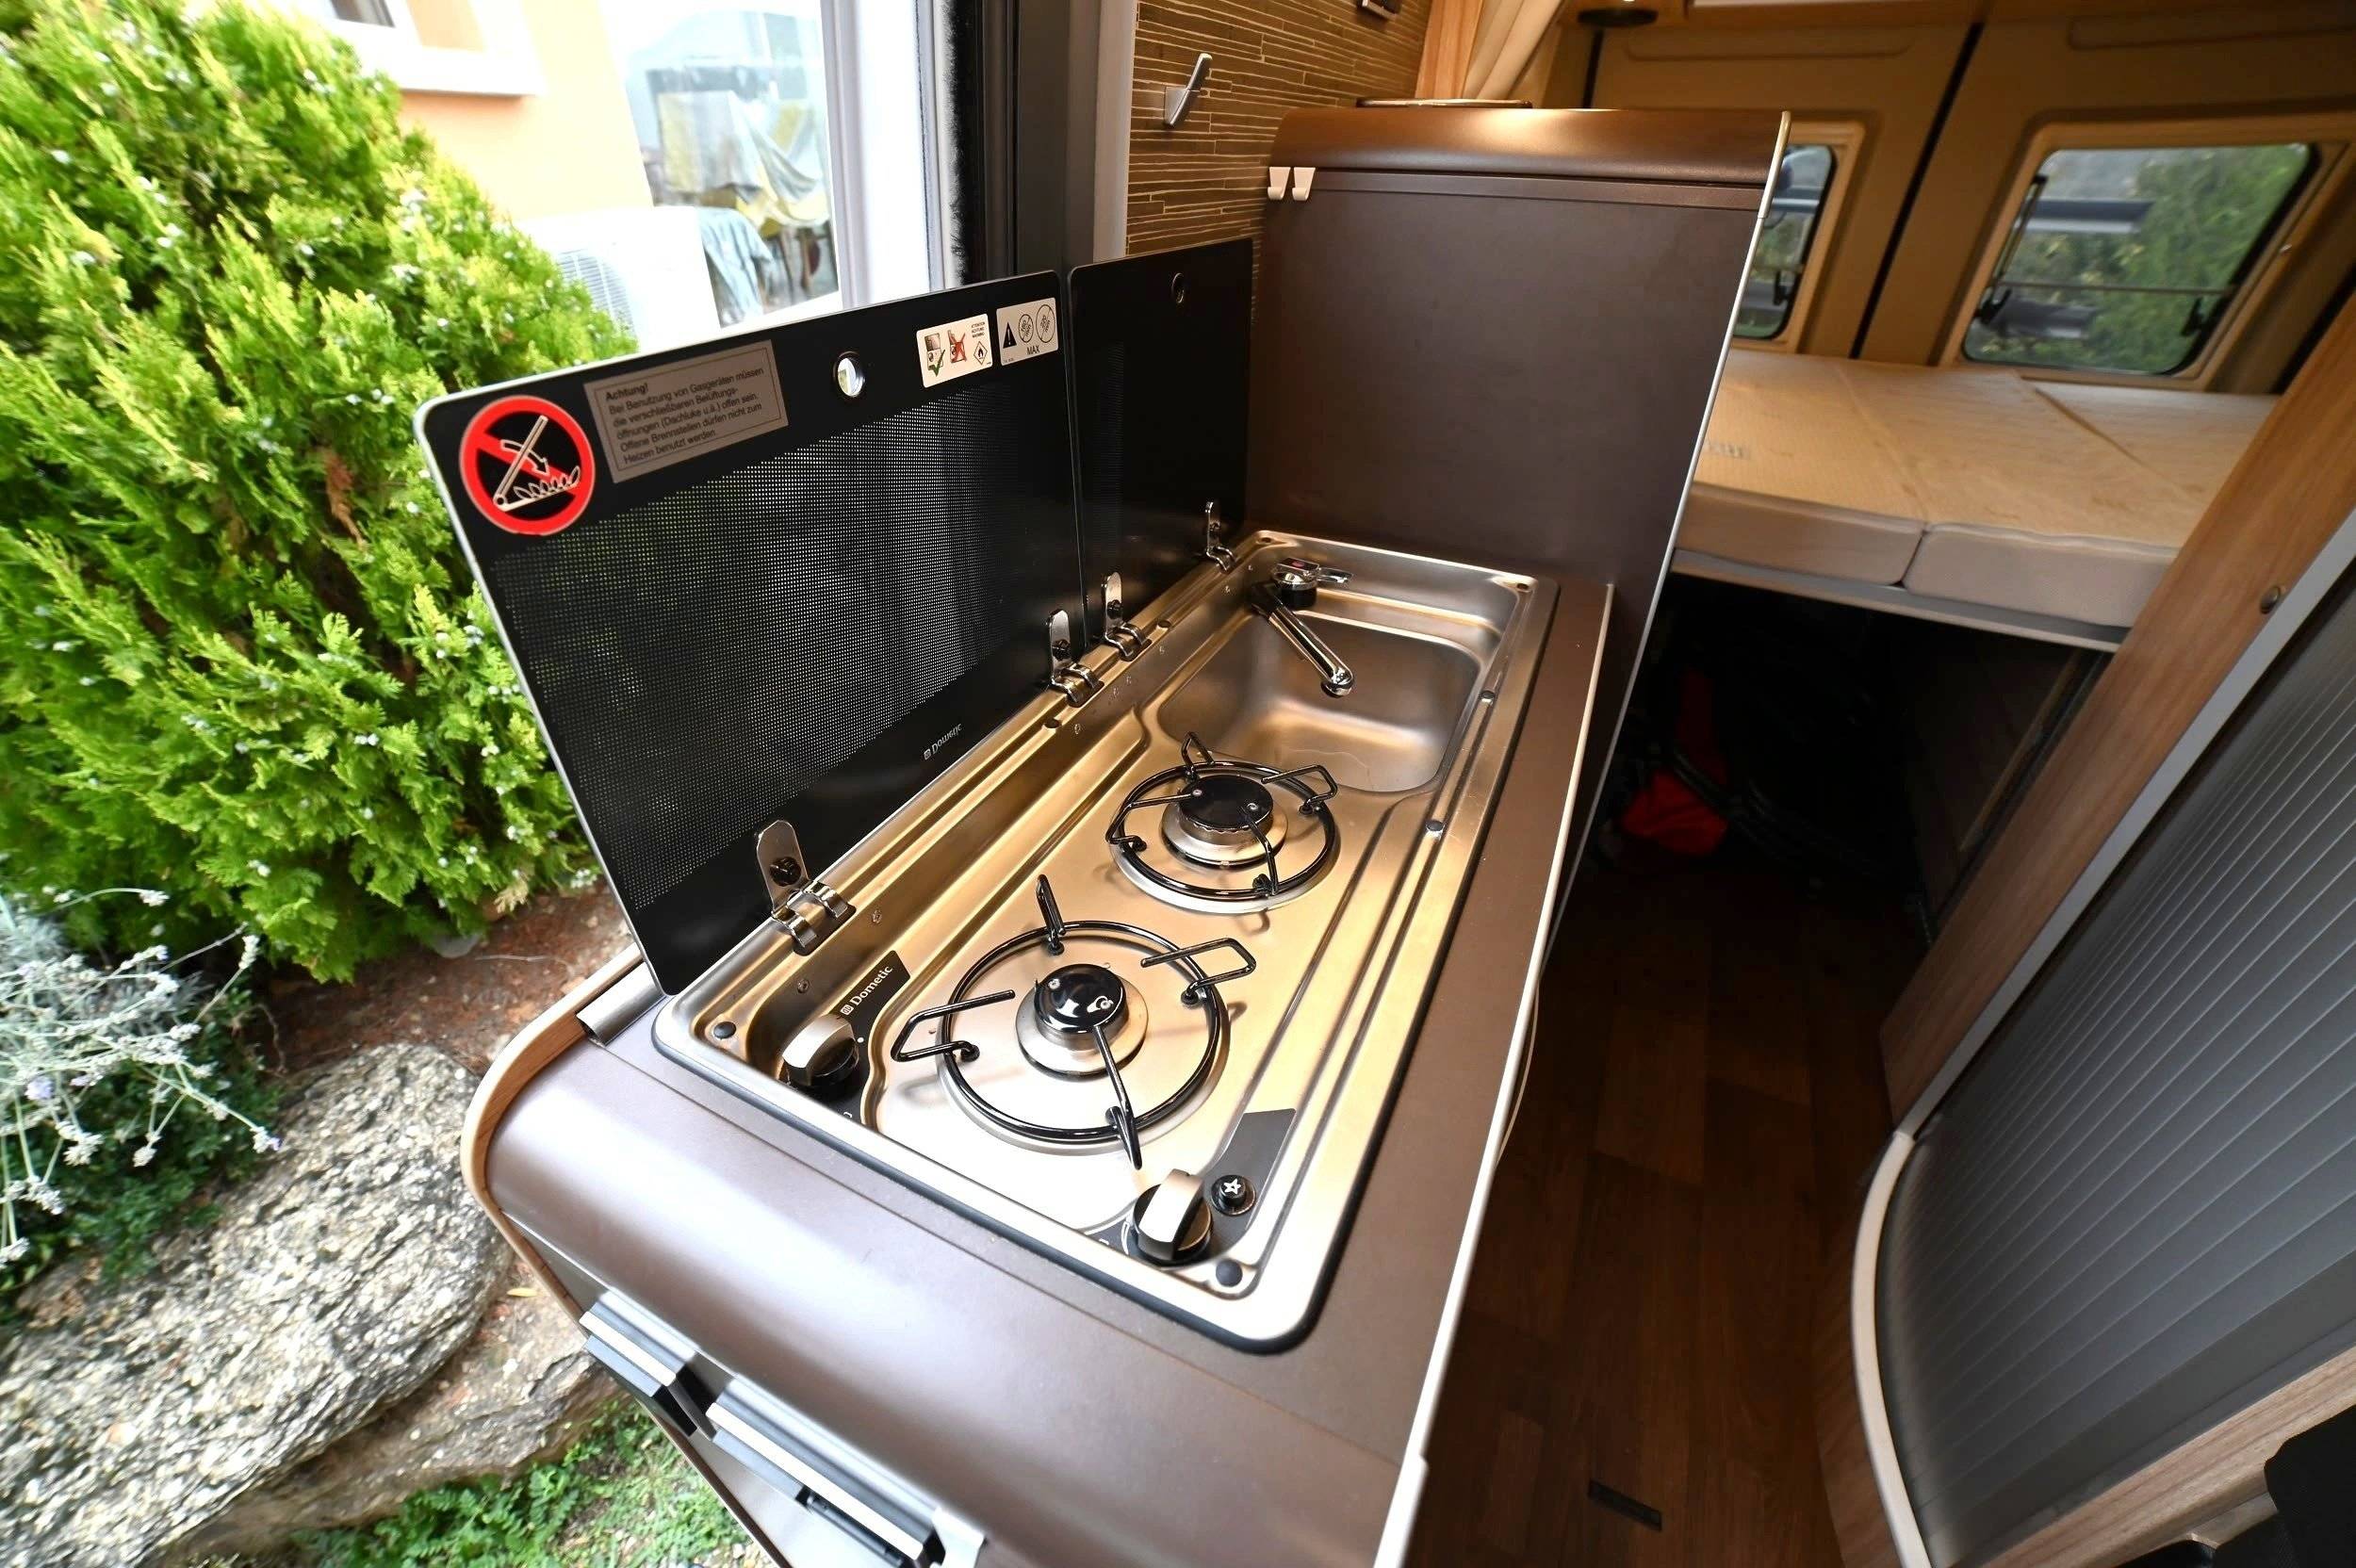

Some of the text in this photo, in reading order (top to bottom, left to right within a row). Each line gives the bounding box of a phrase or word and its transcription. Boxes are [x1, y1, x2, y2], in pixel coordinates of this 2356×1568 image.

[1026, 345, 1040, 355] MAX
[605, 383, 649, 401] Achtung!
[609, 367, 765, 416] Bei Benutzung von Gasgeräten müssen
[613, 416, 628, 428] die
[620, 403, 762, 453] Offene Brennstellen dürfen nicht zum
[662, 409, 702, 430] (Dachluke
[722, 397, 740, 409] offen
[623, 449, 655, 465] Heizen
[656, 437, 687, 455] benutzt
[849, 966, 893, 1006] Dometic
